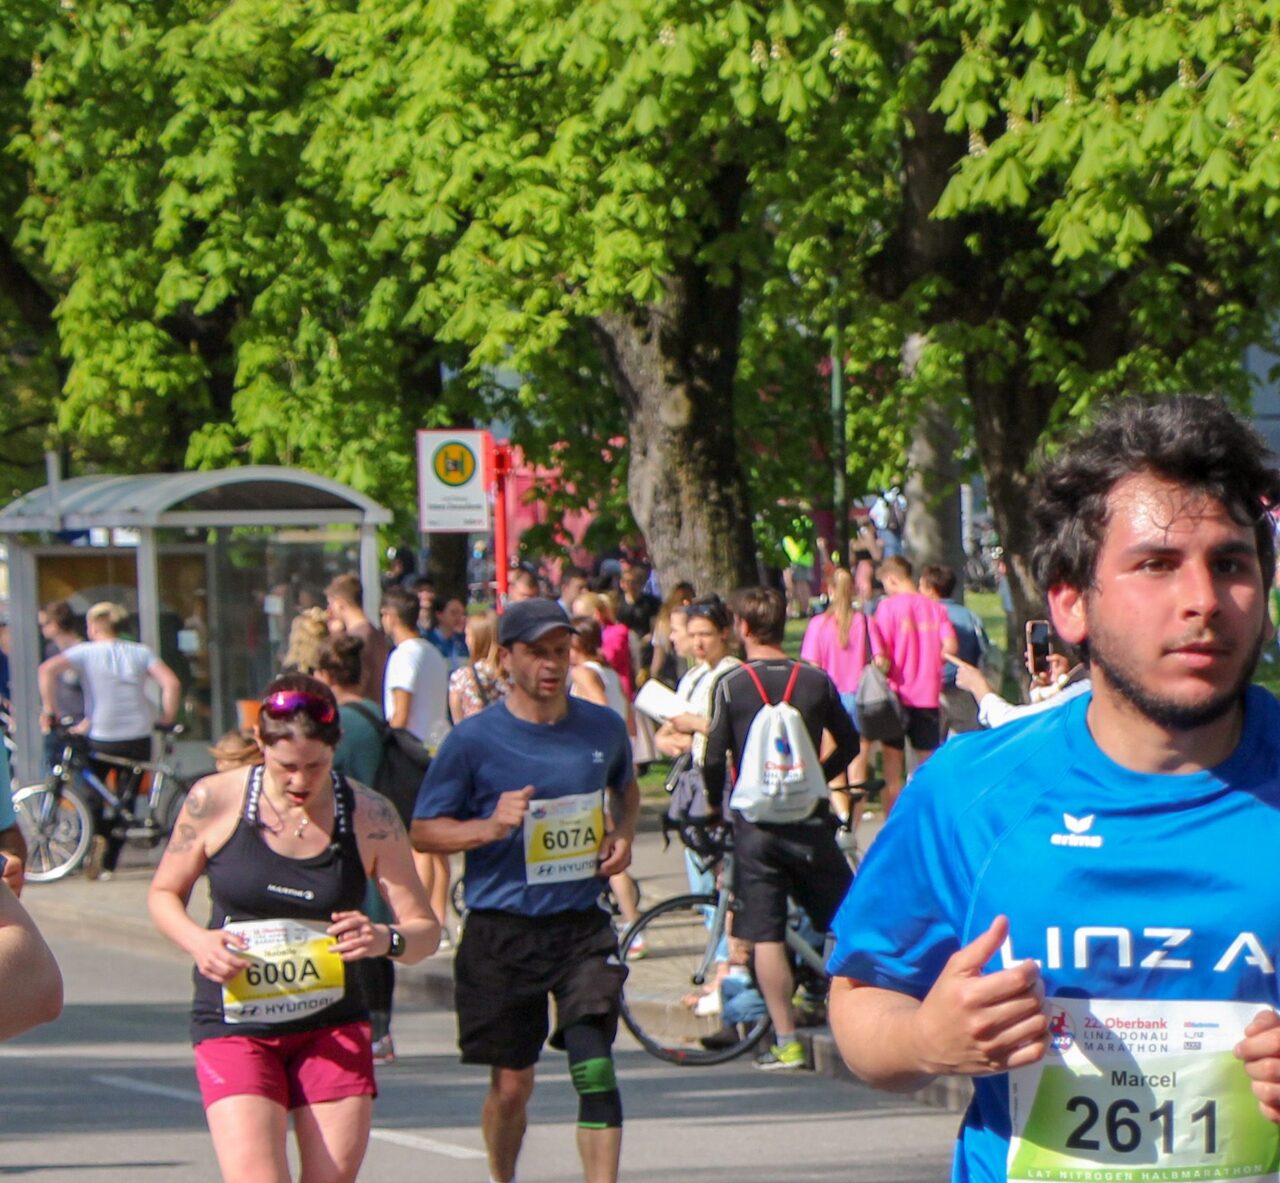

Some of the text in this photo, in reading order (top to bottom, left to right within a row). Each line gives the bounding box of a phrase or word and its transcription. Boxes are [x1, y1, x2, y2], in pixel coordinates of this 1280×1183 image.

[542, 826, 597, 850] 607A
[1050, 833, 1103, 848] erima
[1000, 925, 1194, 970] LINZ
[246, 958, 321, 987] 600A
[1104, 1017, 1168, 1030] Oberbank
[1083, 1030, 1169, 1041] LINZ DONAU
[1083, 1042, 1169, 1053] MARATHON
[1110, 1070, 1177, 1089] Marcel
[1065, 1095, 1217, 1155] 2611
[1027, 1163, 1263, 1182] LAT NITROGEN HALBMARATHON
